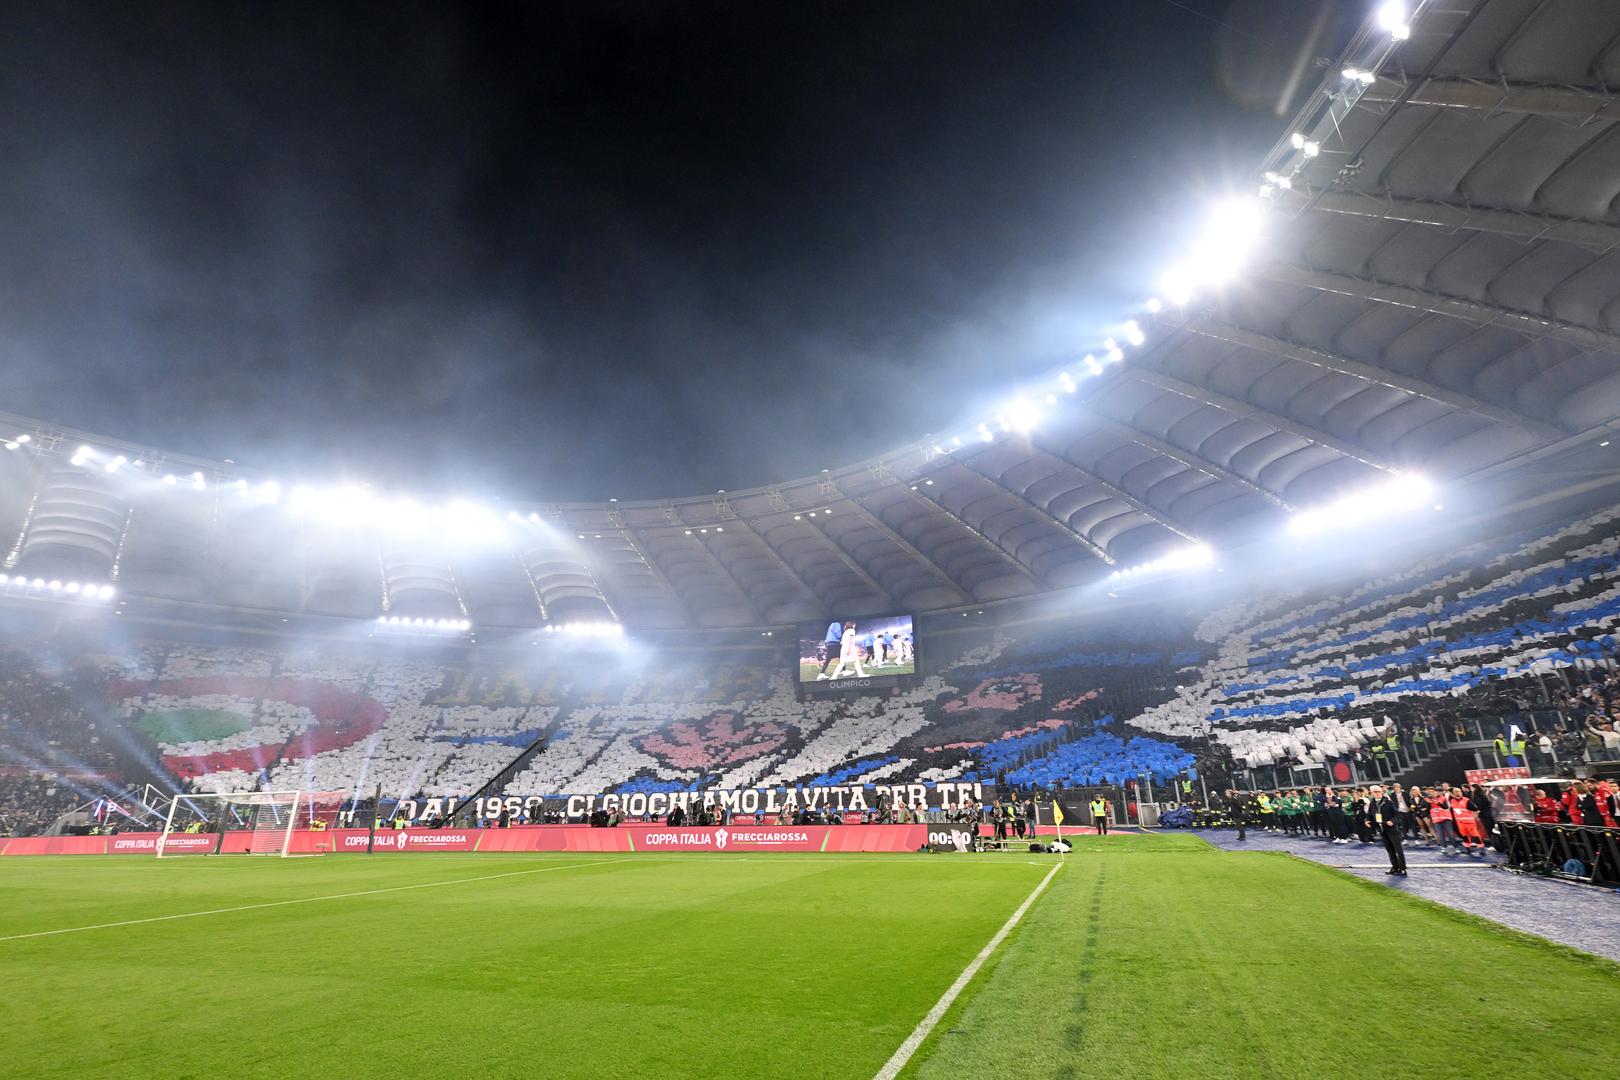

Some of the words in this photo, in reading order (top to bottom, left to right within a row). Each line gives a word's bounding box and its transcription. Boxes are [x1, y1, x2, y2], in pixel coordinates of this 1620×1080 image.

[830, 680, 870, 689] OLIMPICO
[766, 787, 798, 813] LA
[803, 786, 868, 812] VITA
[115, 840, 135, 848] COPPA
[135, 839, 154, 848] ITALIA
[166, 838, 210, 846] FRECCIAROSSA
[345, 836, 370, 846] COPPA
[371, 835, 395, 846] TALIA
[409, 835, 466, 843] FRECCIAROSSA
[645, 833, 679, 845] COPPA
[680, 833, 712, 845] ITALIA
[732, 832, 808, 841] FRECCIAROSSA
[928, 832, 971, 845] 00:0
